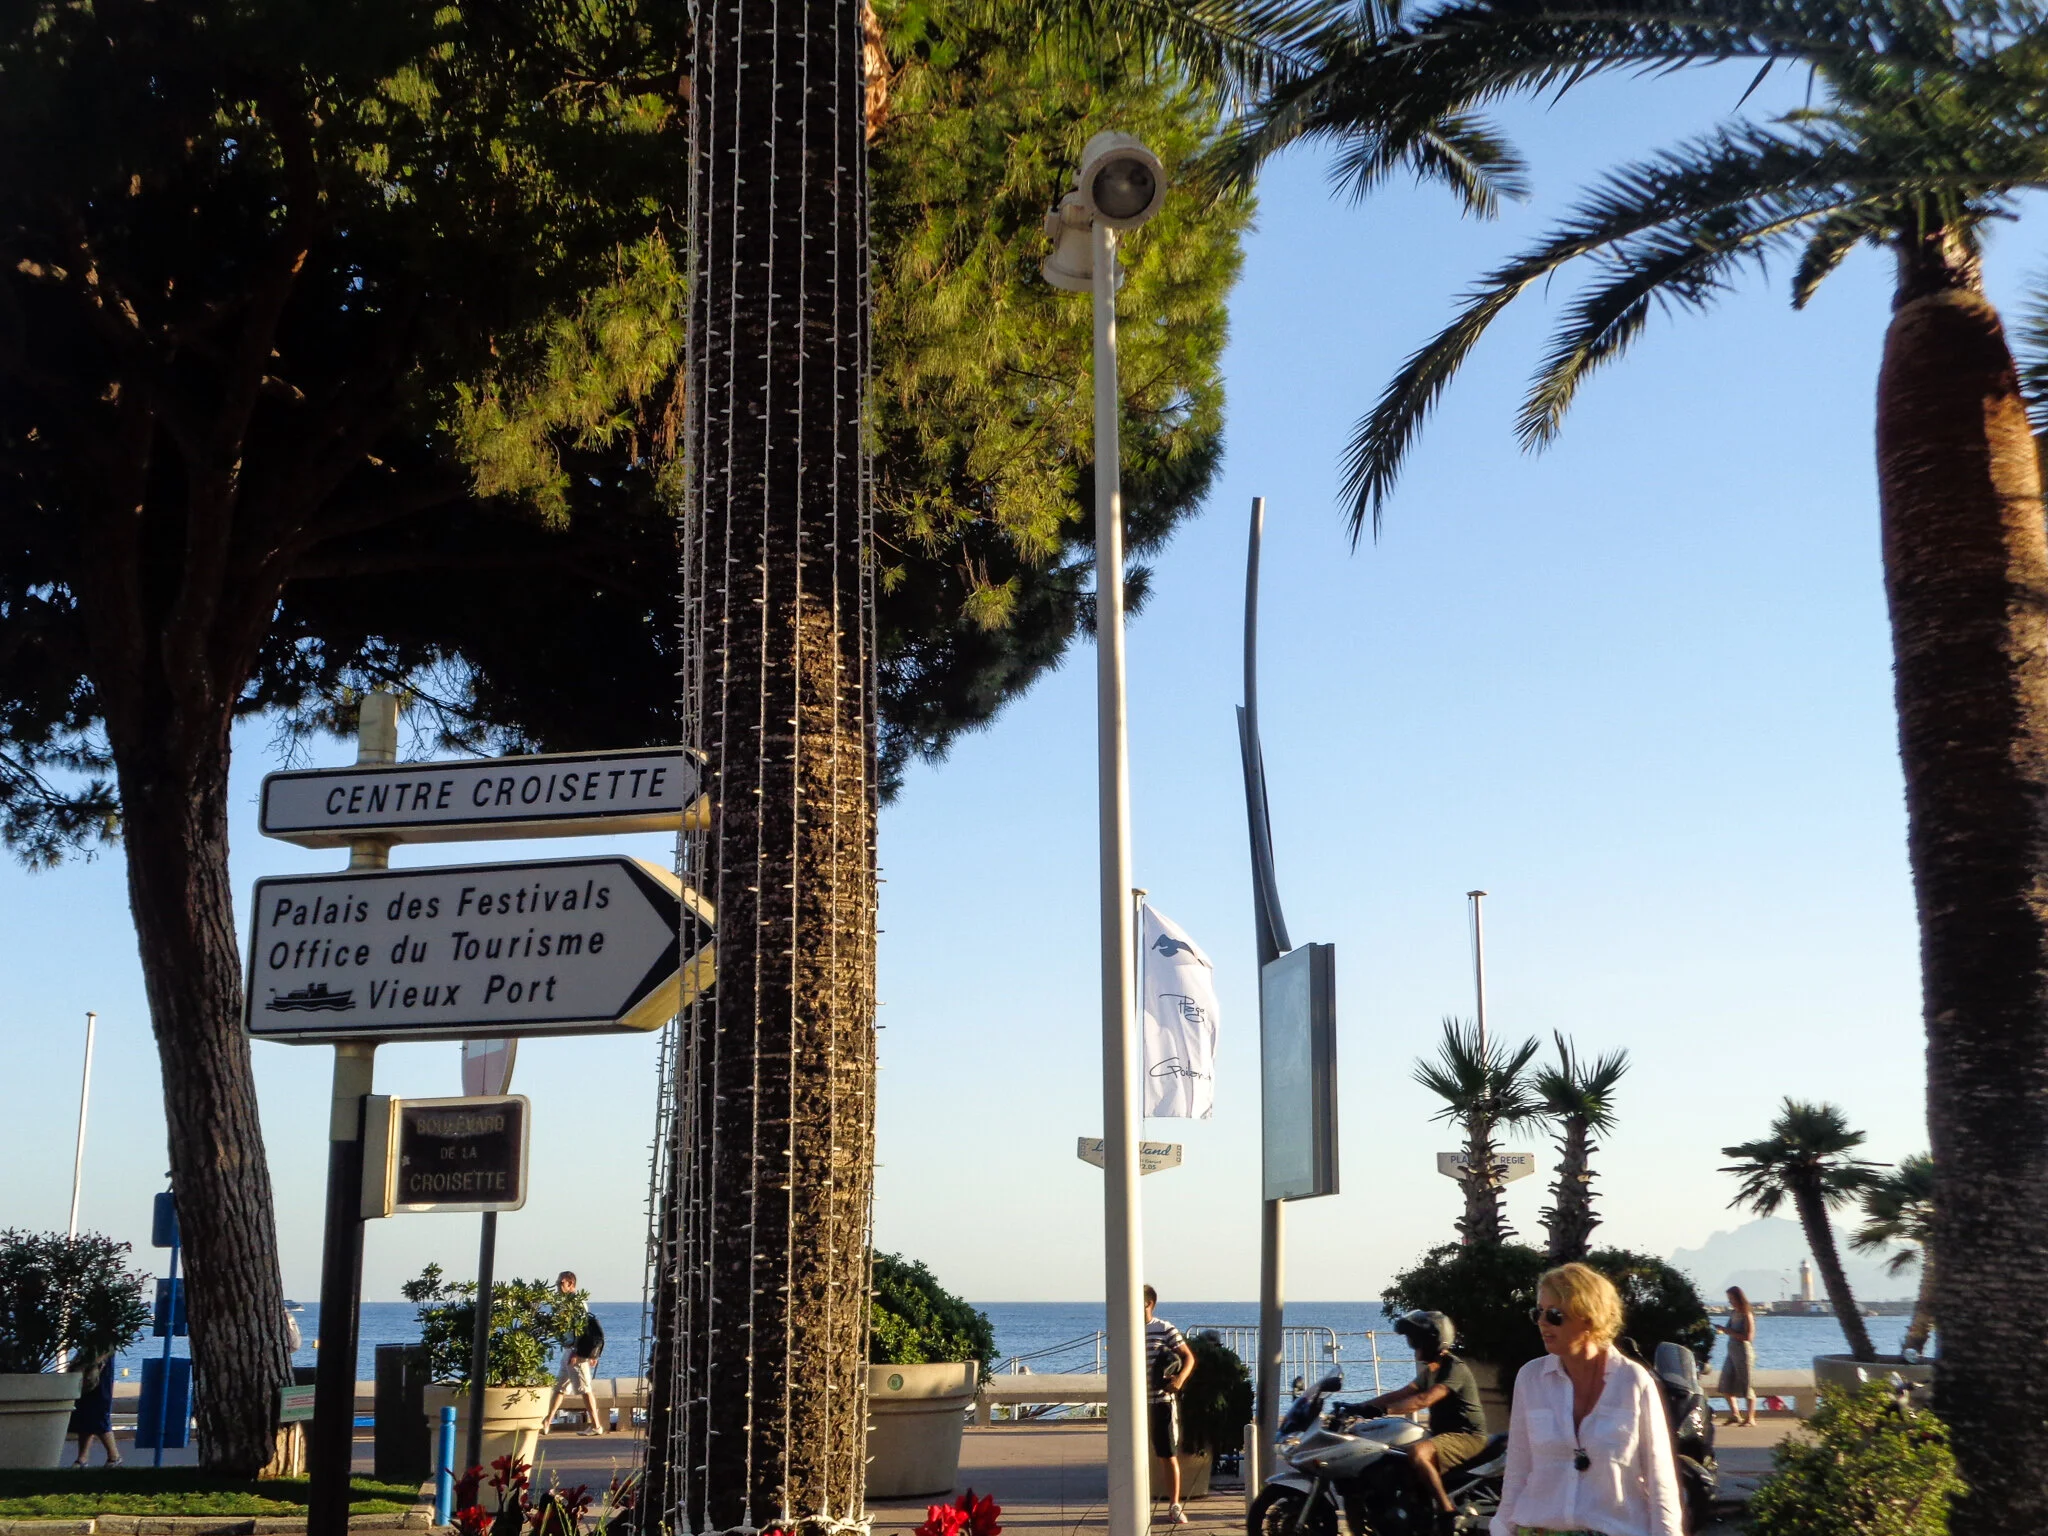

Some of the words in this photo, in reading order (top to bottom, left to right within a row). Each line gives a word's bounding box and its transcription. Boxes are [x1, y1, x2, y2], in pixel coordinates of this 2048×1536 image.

[326, 781, 454, 815] CENTRE
[473, 768, 666, 807] CROISETTE
[272, 895, 369, 927] Palais
[387, 892, 440, 921] des
[457, 880, 610, 916] Festivals
[269, 939, 370, 969] Office
[391, 935, 427, 964] du
[452, 928, 604, 960] Tourisme
[369, 980, 460, 1009] Vieux
[484, 974, 556, 1004] Port
[416, 1115, 505, 1135] BOULEVARD
[440, 1147, 456, 1160] DE
[463, 1146, 478, 1160] LA
[1500, 1155, 1525, 1164] REGIE
[410, 1172, 506, 1192] CROISETTE
